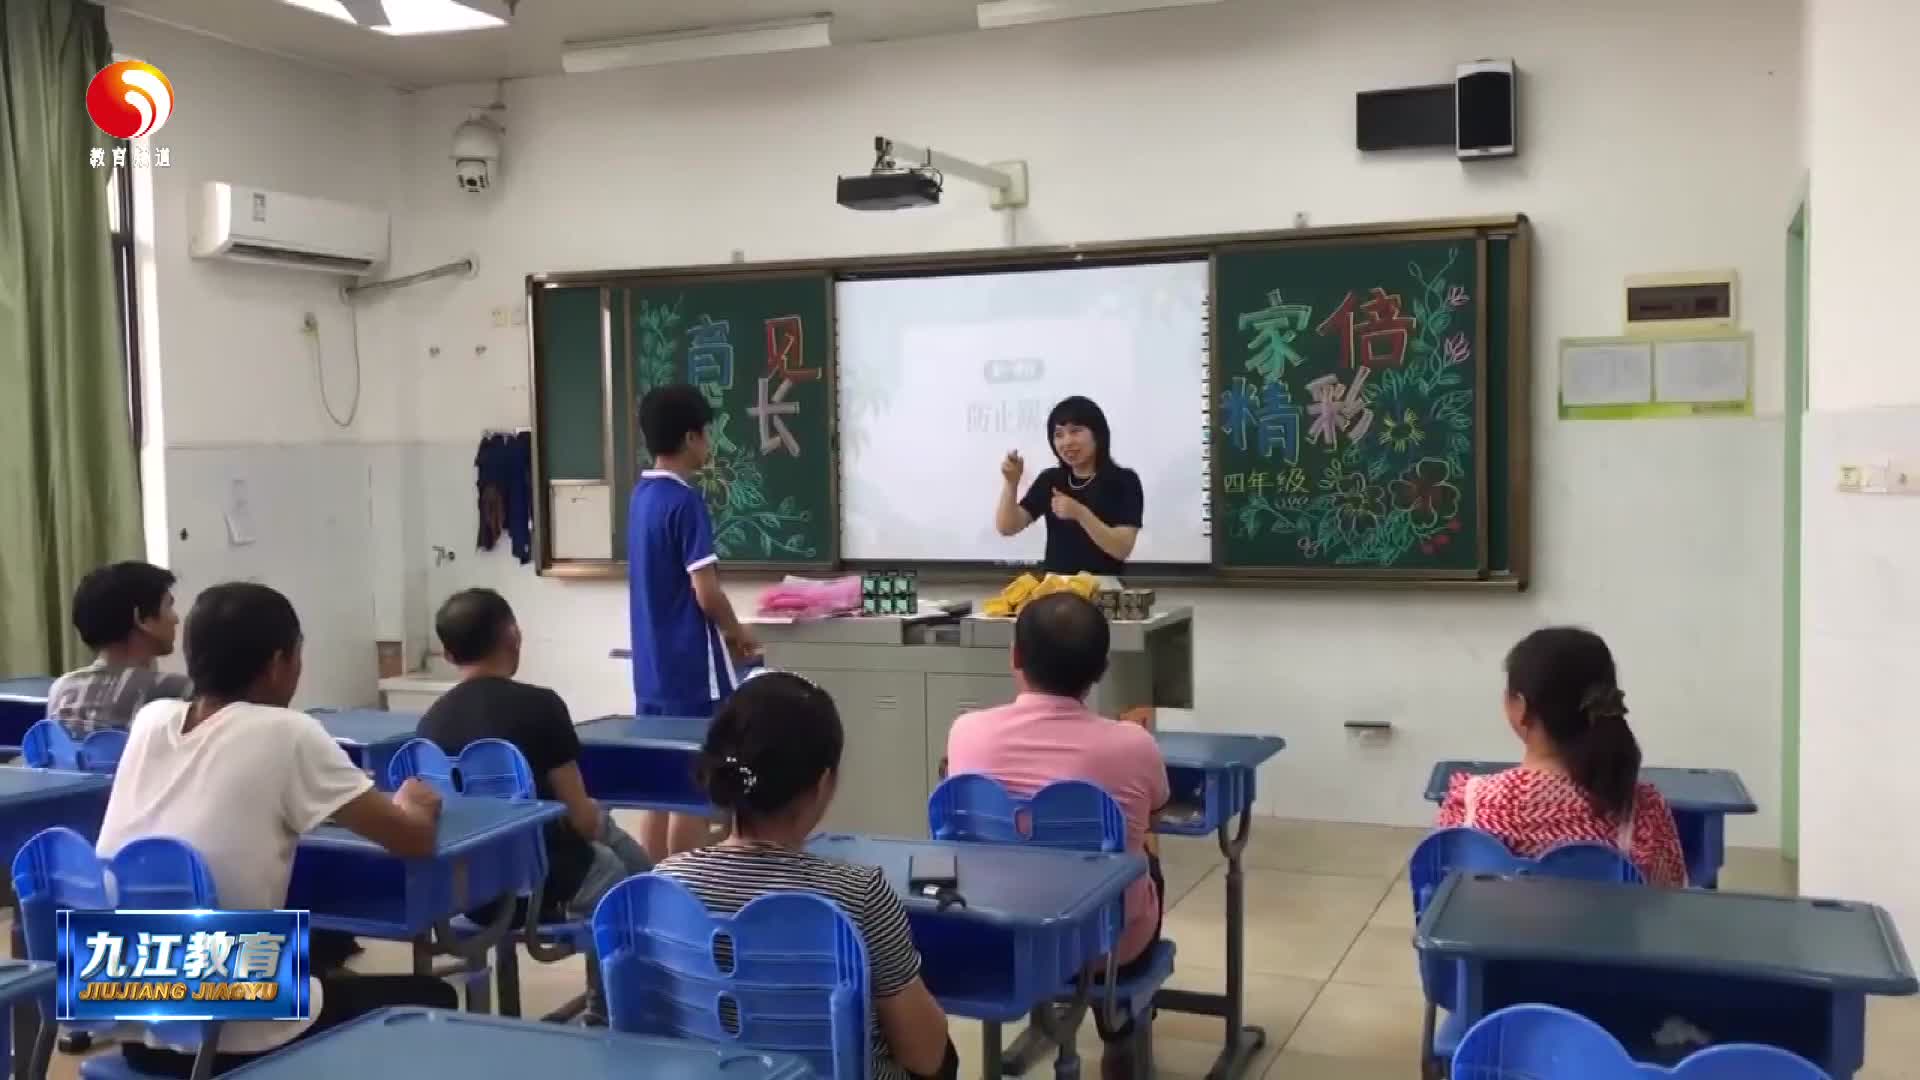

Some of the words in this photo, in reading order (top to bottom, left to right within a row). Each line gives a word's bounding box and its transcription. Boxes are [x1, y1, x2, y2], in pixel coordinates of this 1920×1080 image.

[1238, 288, 1417, 380] 家倍
[1219, 367, 1375, 465] 精彩
[1223, 469, 1310, 495] 四年级
